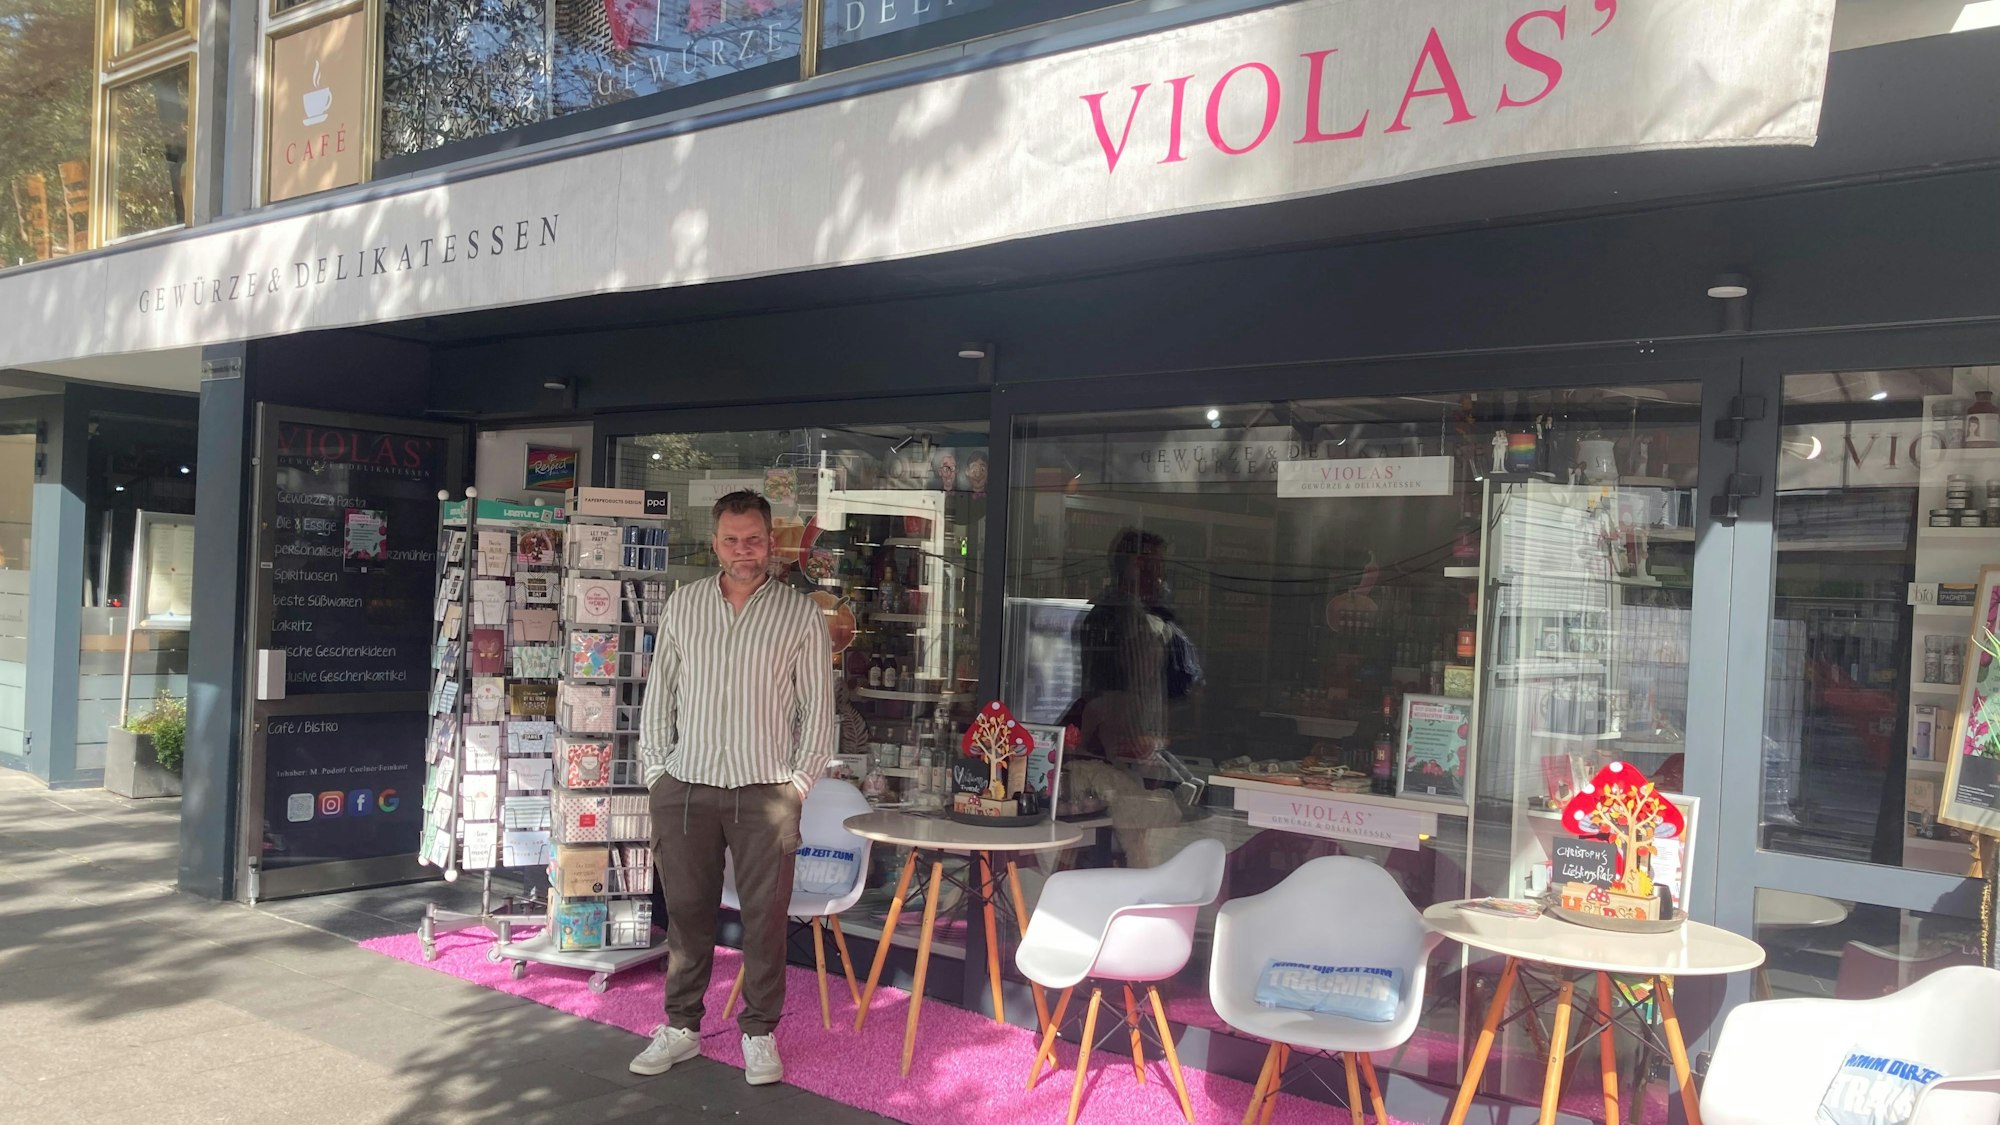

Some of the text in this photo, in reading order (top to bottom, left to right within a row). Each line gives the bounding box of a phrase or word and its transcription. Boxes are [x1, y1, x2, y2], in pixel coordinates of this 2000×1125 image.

[845, 0, 958, 32] DEL
[597, 22, 784, 96] GEWÜRZE
[286, 122, 347, 165] CAFÉ
[139, 214, 561, 314] GEWÜRZE & DELIKATESSEN
[350, 464, 430, 477] DELIKATESSEN
[1301, 481, 1342, 490] GEWÜRZE
[1354, 480, 1422, 489] DELIKATESSEN
[337, 495, 367, 508] Pasta
[647, 498, 666, 507] ppd
[304, 517, 337, 536] Essige
[385, 549, 437, 562] rzmühlen
[274, 569, 338, 583] Spirituosen
[272, 594, 363, 608] beste Süßwaren
[271, 619, 313, 632] Lakritz
[315, 644, 396, 657] Geschenkideen
[319, 669, 407, 683] Geschenkartikel
[267, 720, 295, 734] Café
[304, 720, 339, 733] Bistro
[1324, 822, 1393, 840] DELIKATESSEN
[812, 848, 832, 858] ZEIT
[832, 850, 854, 861] ZUM
[1363, 967, 1393, 978] ZUM
